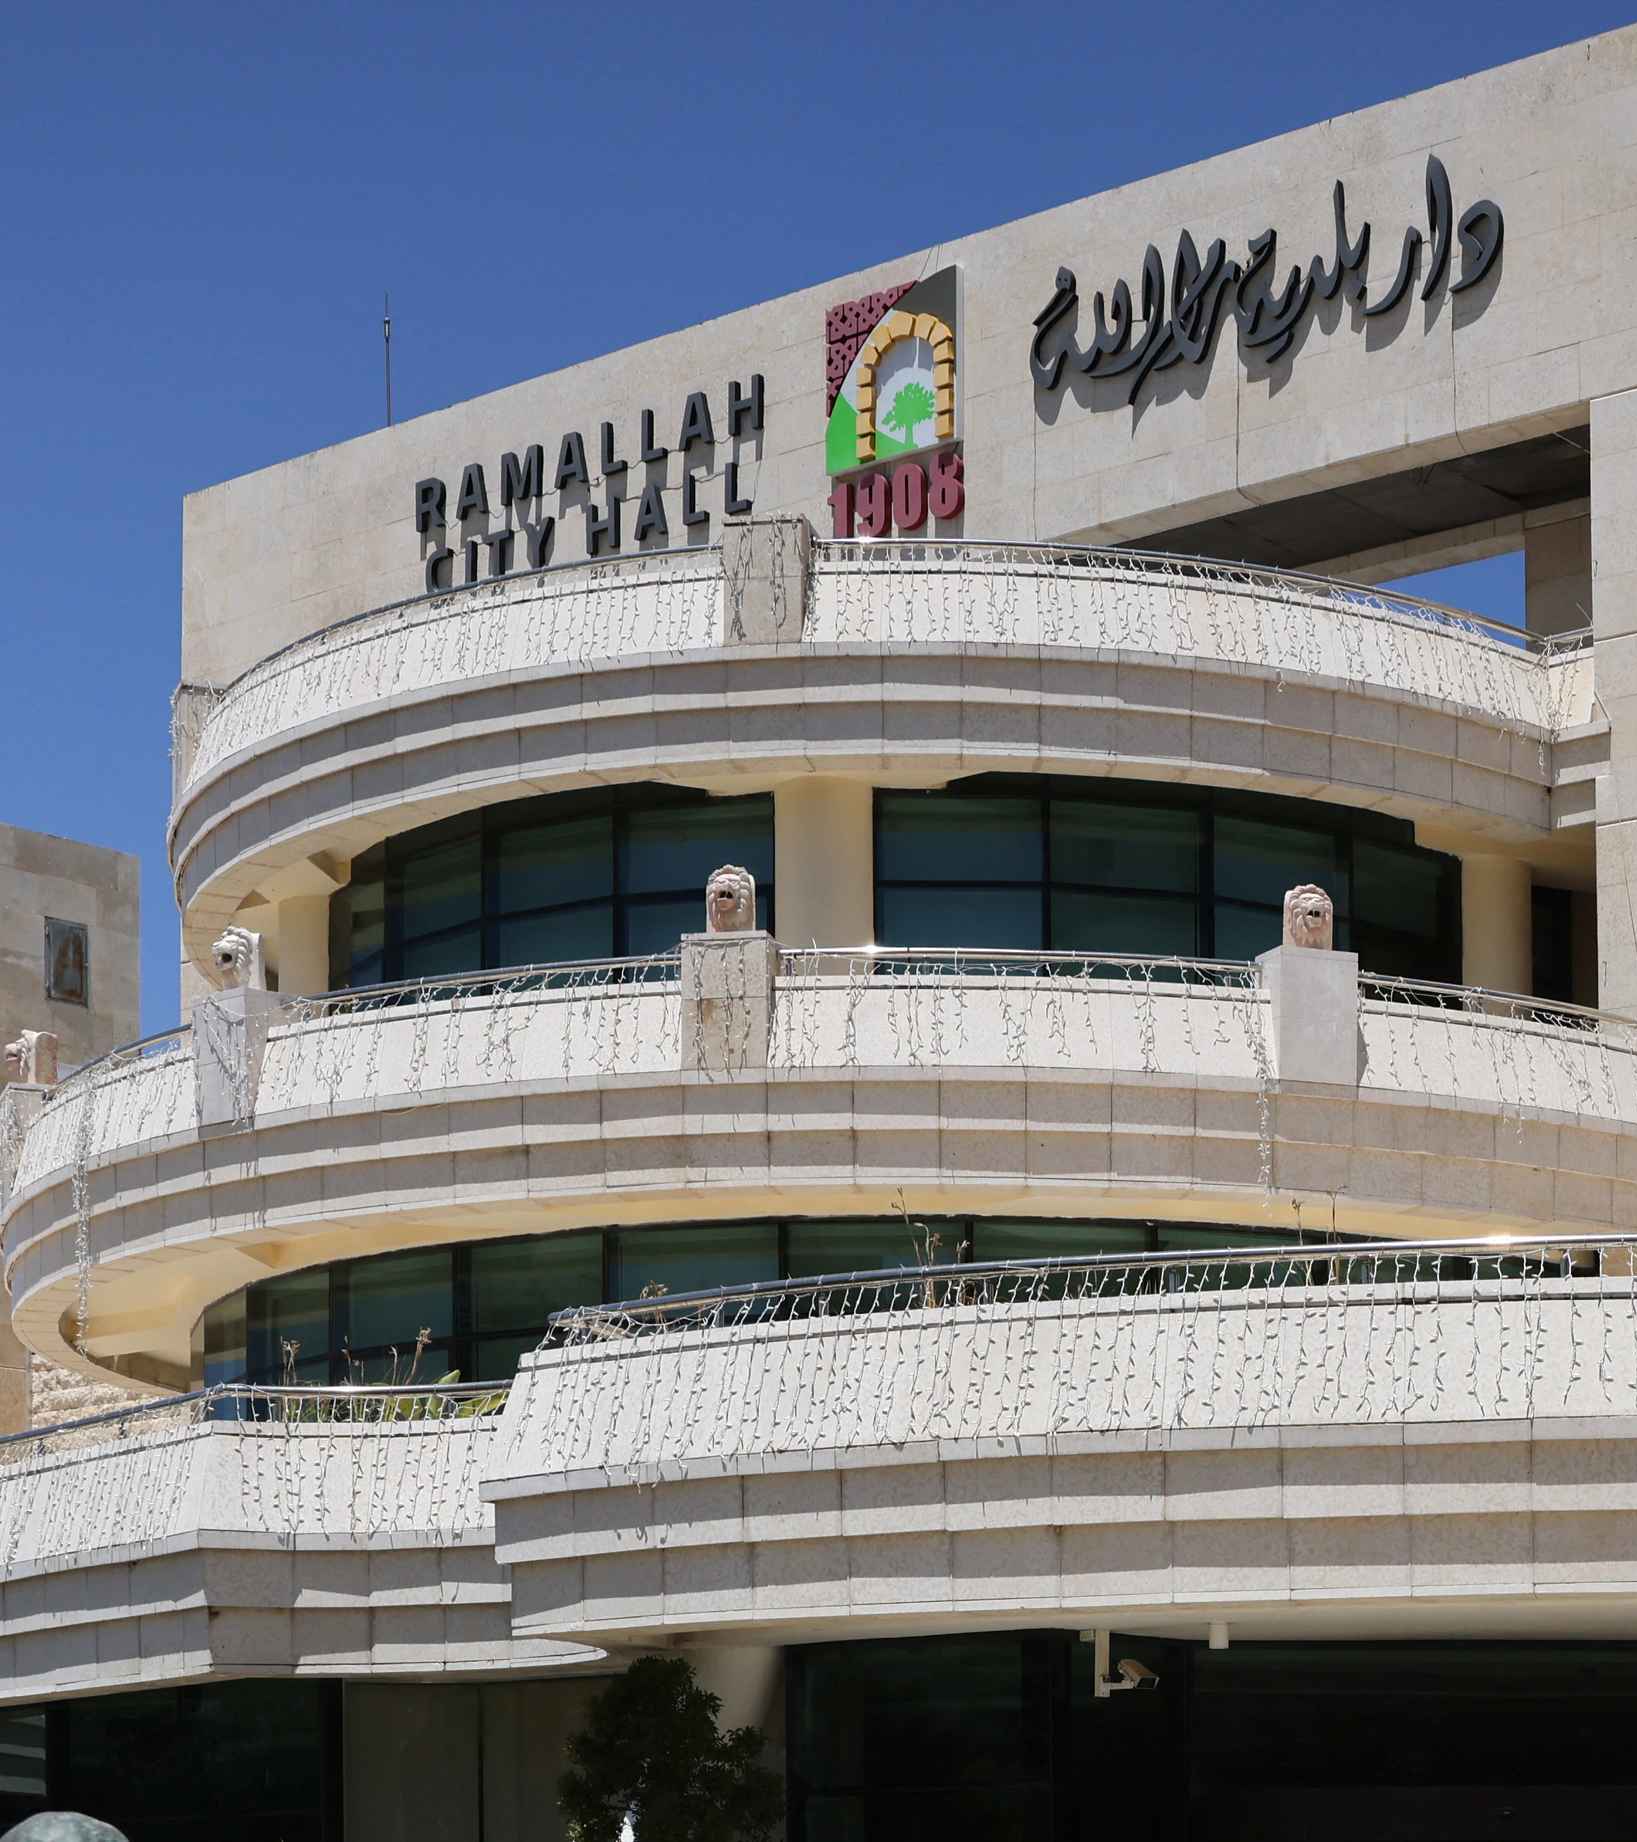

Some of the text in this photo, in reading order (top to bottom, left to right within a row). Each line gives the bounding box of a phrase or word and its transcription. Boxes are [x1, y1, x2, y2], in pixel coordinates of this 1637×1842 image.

[1362, 153, 1504, 317] دار
[415, 373, 765, 534] RAMALLAH
[827, 453, 966, 539] 1908
[425, 462, 754, 594] CITY HALL
